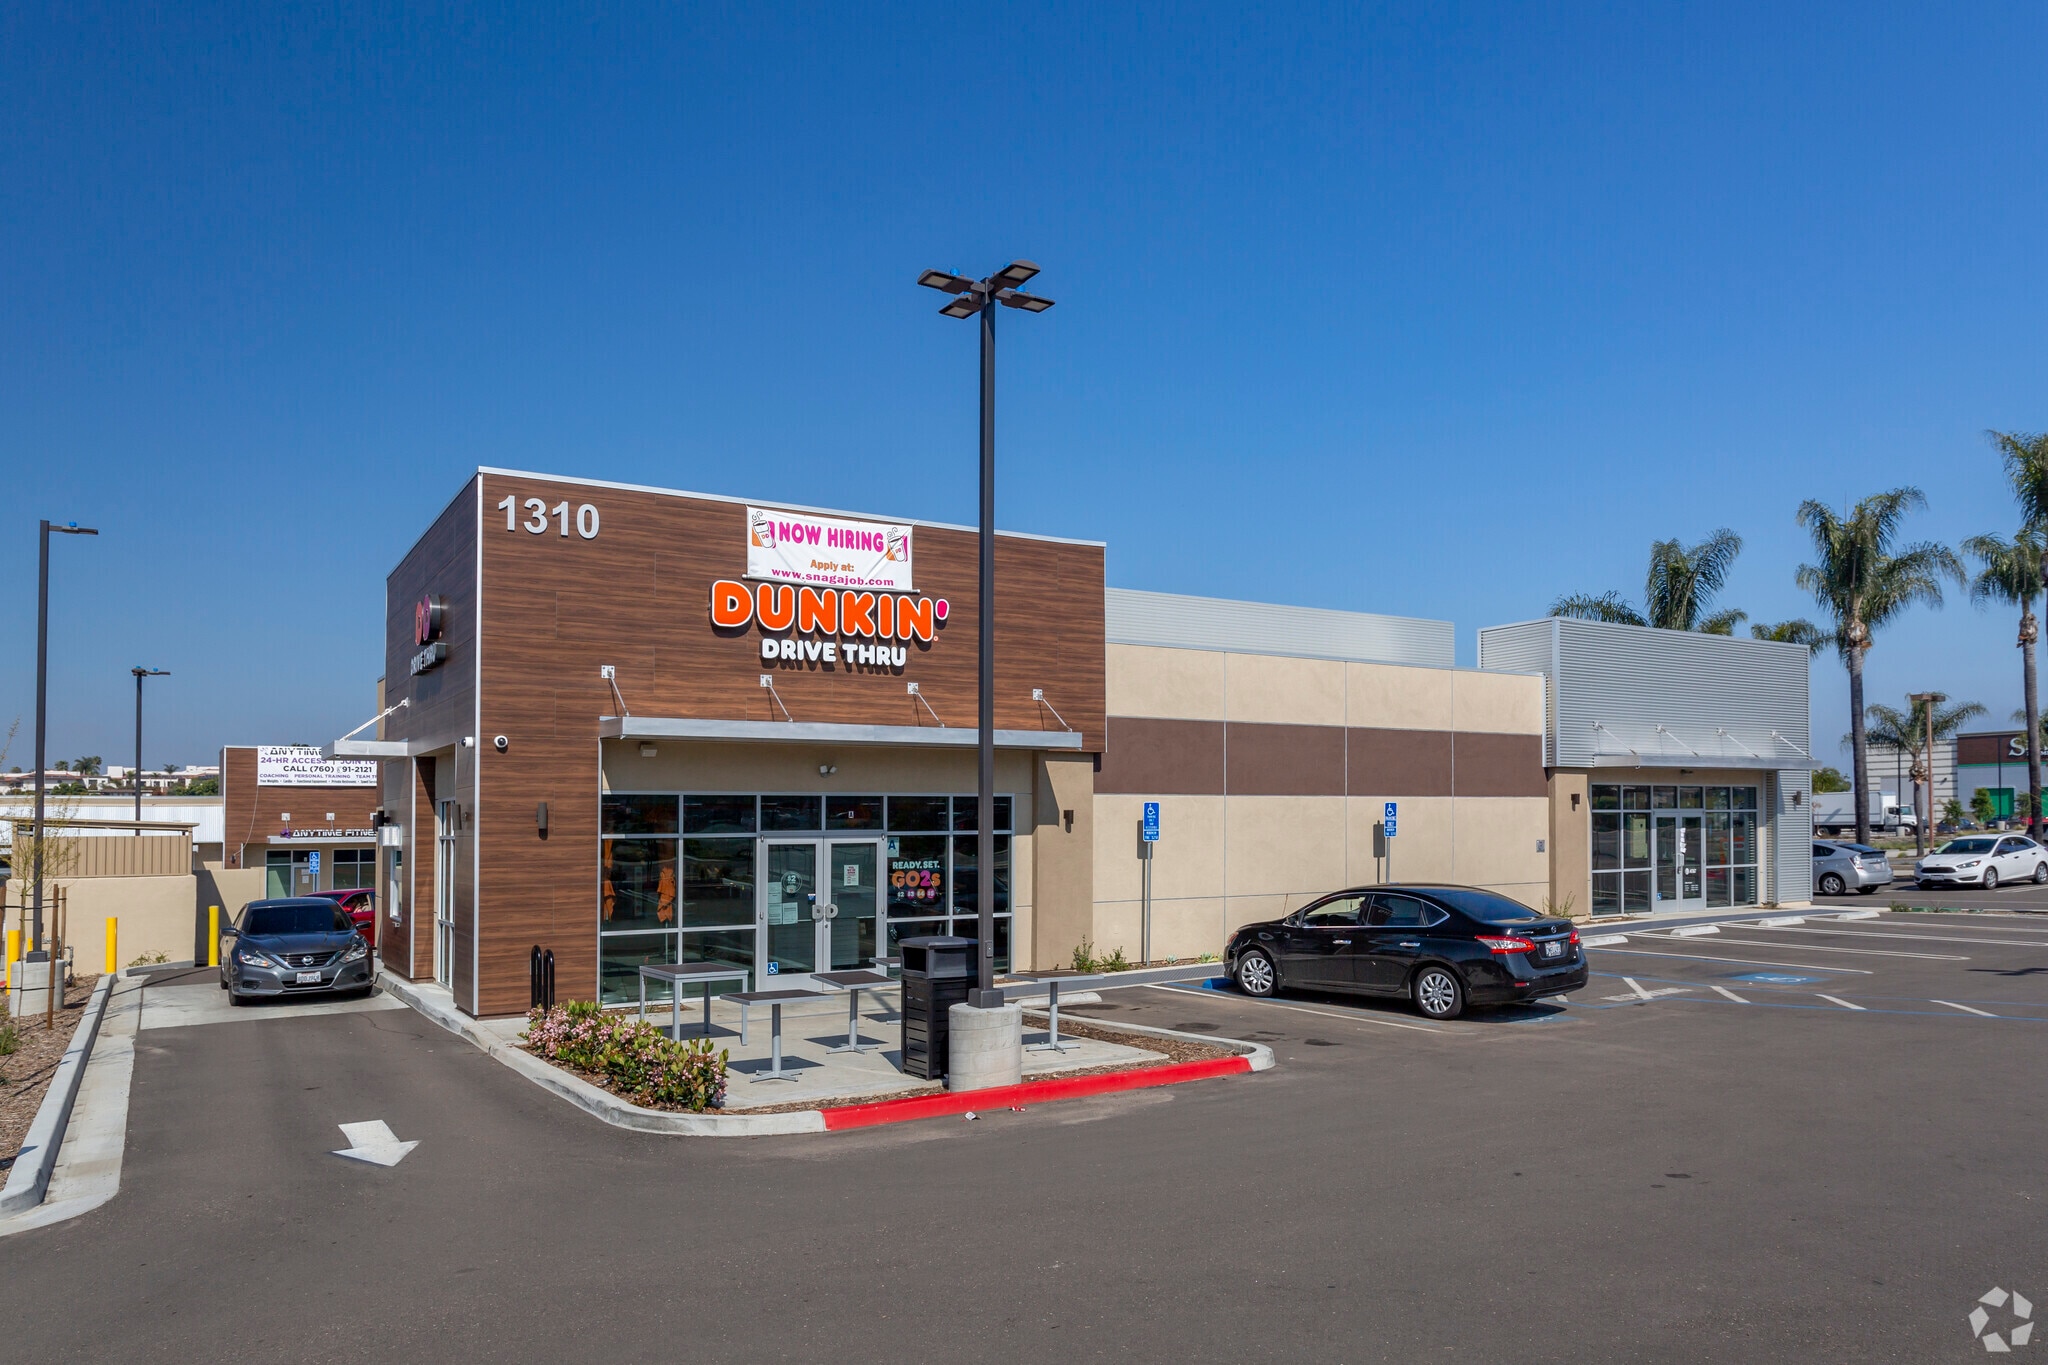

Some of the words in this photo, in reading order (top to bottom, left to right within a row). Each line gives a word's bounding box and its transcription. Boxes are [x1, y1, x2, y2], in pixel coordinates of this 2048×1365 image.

[498, 495, 600, 539] 1310
[779, 521, 822, 546] NOW
[827, 527, 884, 553] HIRING
[810, 559, 838, 572] Apply
[840, 563, 855, 572] at:
[771, 568, 894, 586] www.snagajob.com
[712, 580, 949, 642] DUNKIN'
[762, 638, 836, 663] DRIVE
[842, 643, 906, 667] THRU
[291, 757, 327, 765] ACCESS
[309, 765, 335, 773] (760)
[293, 829, 342, 837] ANYTIME
[345, 829, 377, 837] FITNE
[888, 840, 897, 850] A
[892, 861, 922, 870] READY.
[923, 860, 940, 869] SET.
